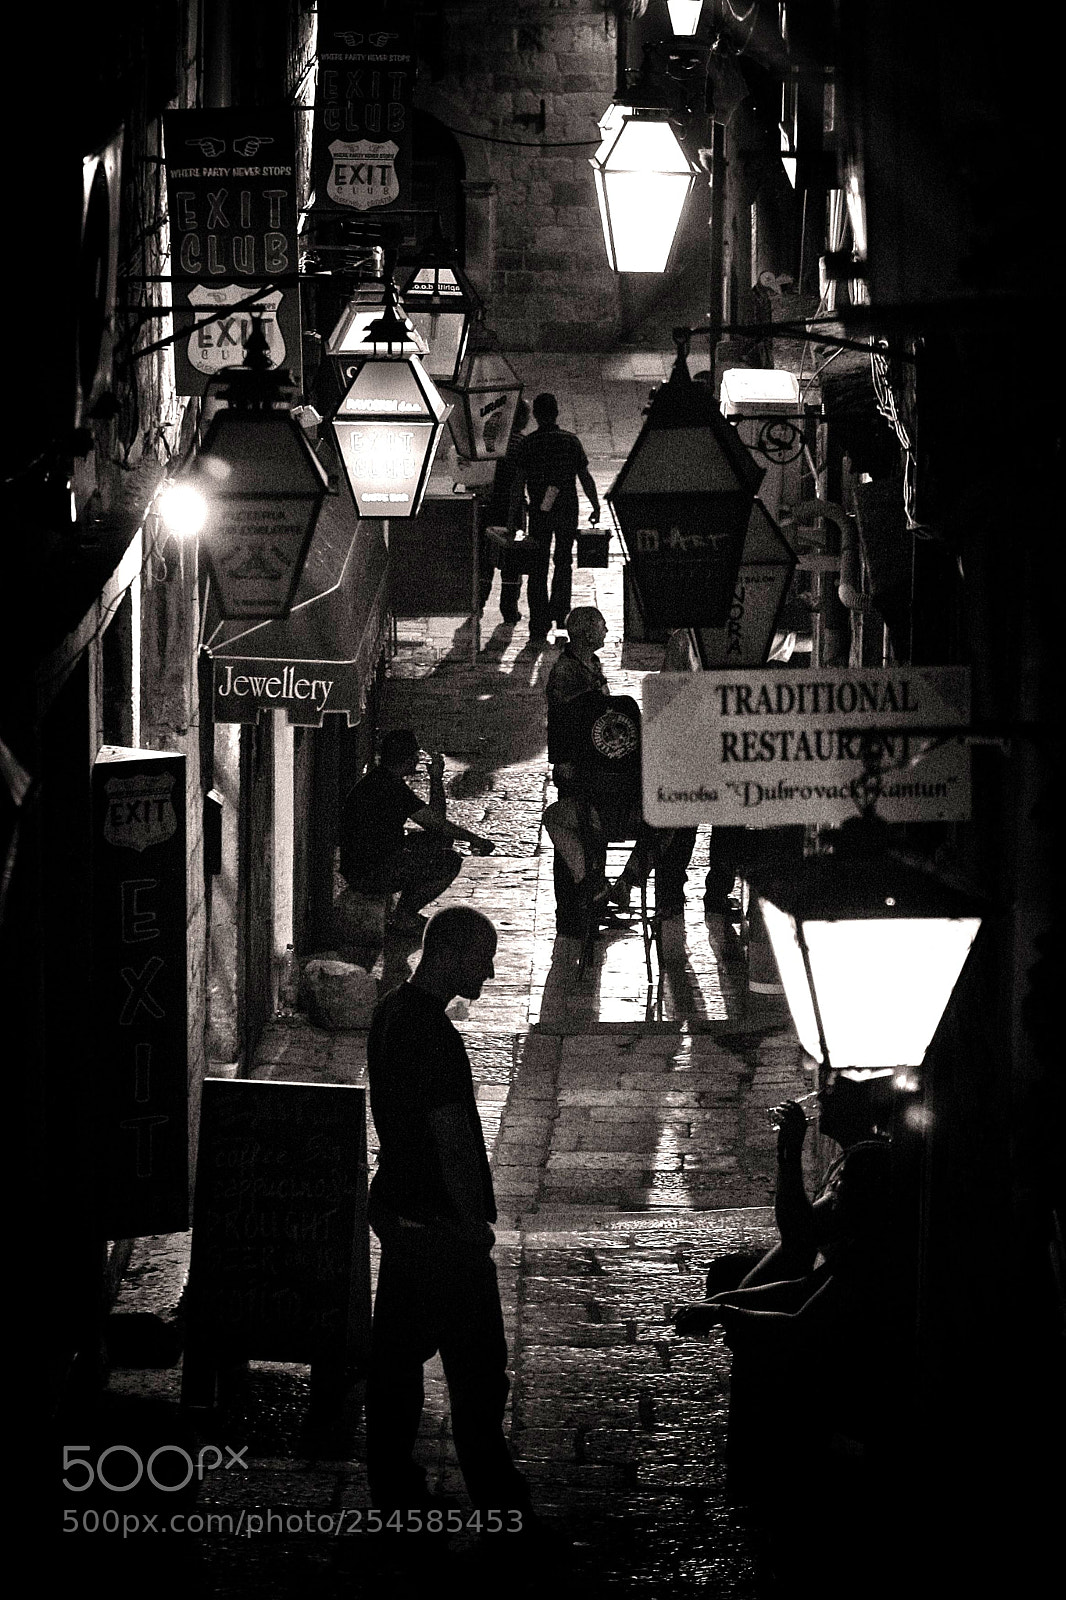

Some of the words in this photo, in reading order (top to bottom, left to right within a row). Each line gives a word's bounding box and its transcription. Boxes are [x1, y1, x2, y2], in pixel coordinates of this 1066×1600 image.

[323, 69, 407, 100] EXIT
[323, 101, 406, 133] CLUB
[170, 168, 200, 179] WHERE
[203, 168, 231, 177] PARTY
[233, 167, 261, 177] NEVER
[262, 166, 292, 176] STOPS
[335, 163, 392, 186] EXIT
[176, 188, 288, 232] EXIT
[180, 232, 288, 274] CLUB
[218, 665, 334, 712] Jewellery
[715, 680, 919, 717] TRADITIONAL
[110, 799, 169, 827] EXIT
[119, 878, 170, 1178] EXIT
